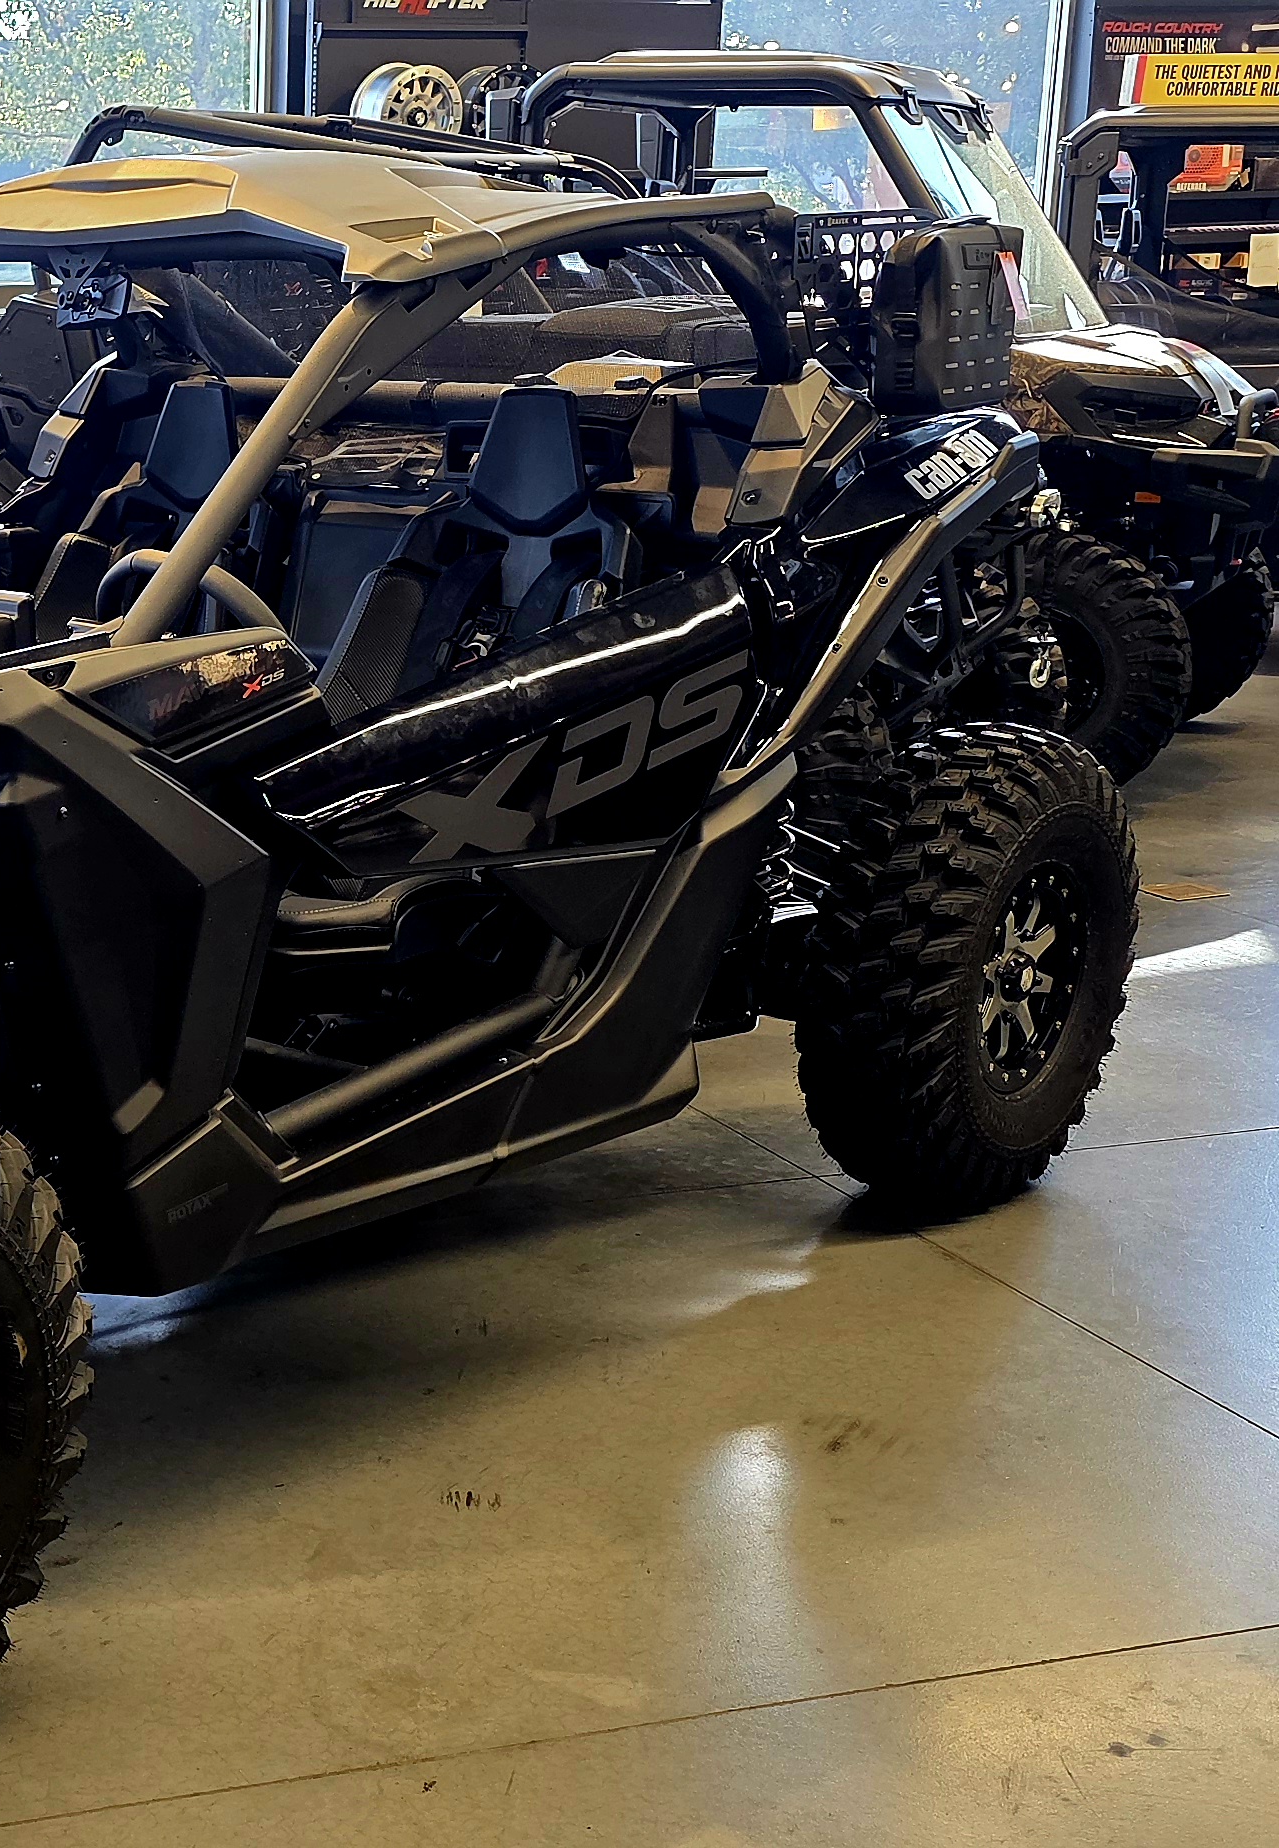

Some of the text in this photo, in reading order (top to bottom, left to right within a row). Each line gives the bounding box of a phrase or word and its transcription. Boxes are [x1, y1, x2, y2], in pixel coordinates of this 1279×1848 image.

[1102, 21, 1223, 34] ROUGH COUNTRY
[1105, 36, 1216, 54] COMMAND THE DARK
[1154, 64, 1178, 79] THE
[1181, 64, 1242, 81] QUIETEST
[1243, 64, 1272, 79] AND
[1166, 81, 1258, 96] COMFORTABLE
[242, 668, 285, 699] XDS
[395, 649, 749, 864] XDS
